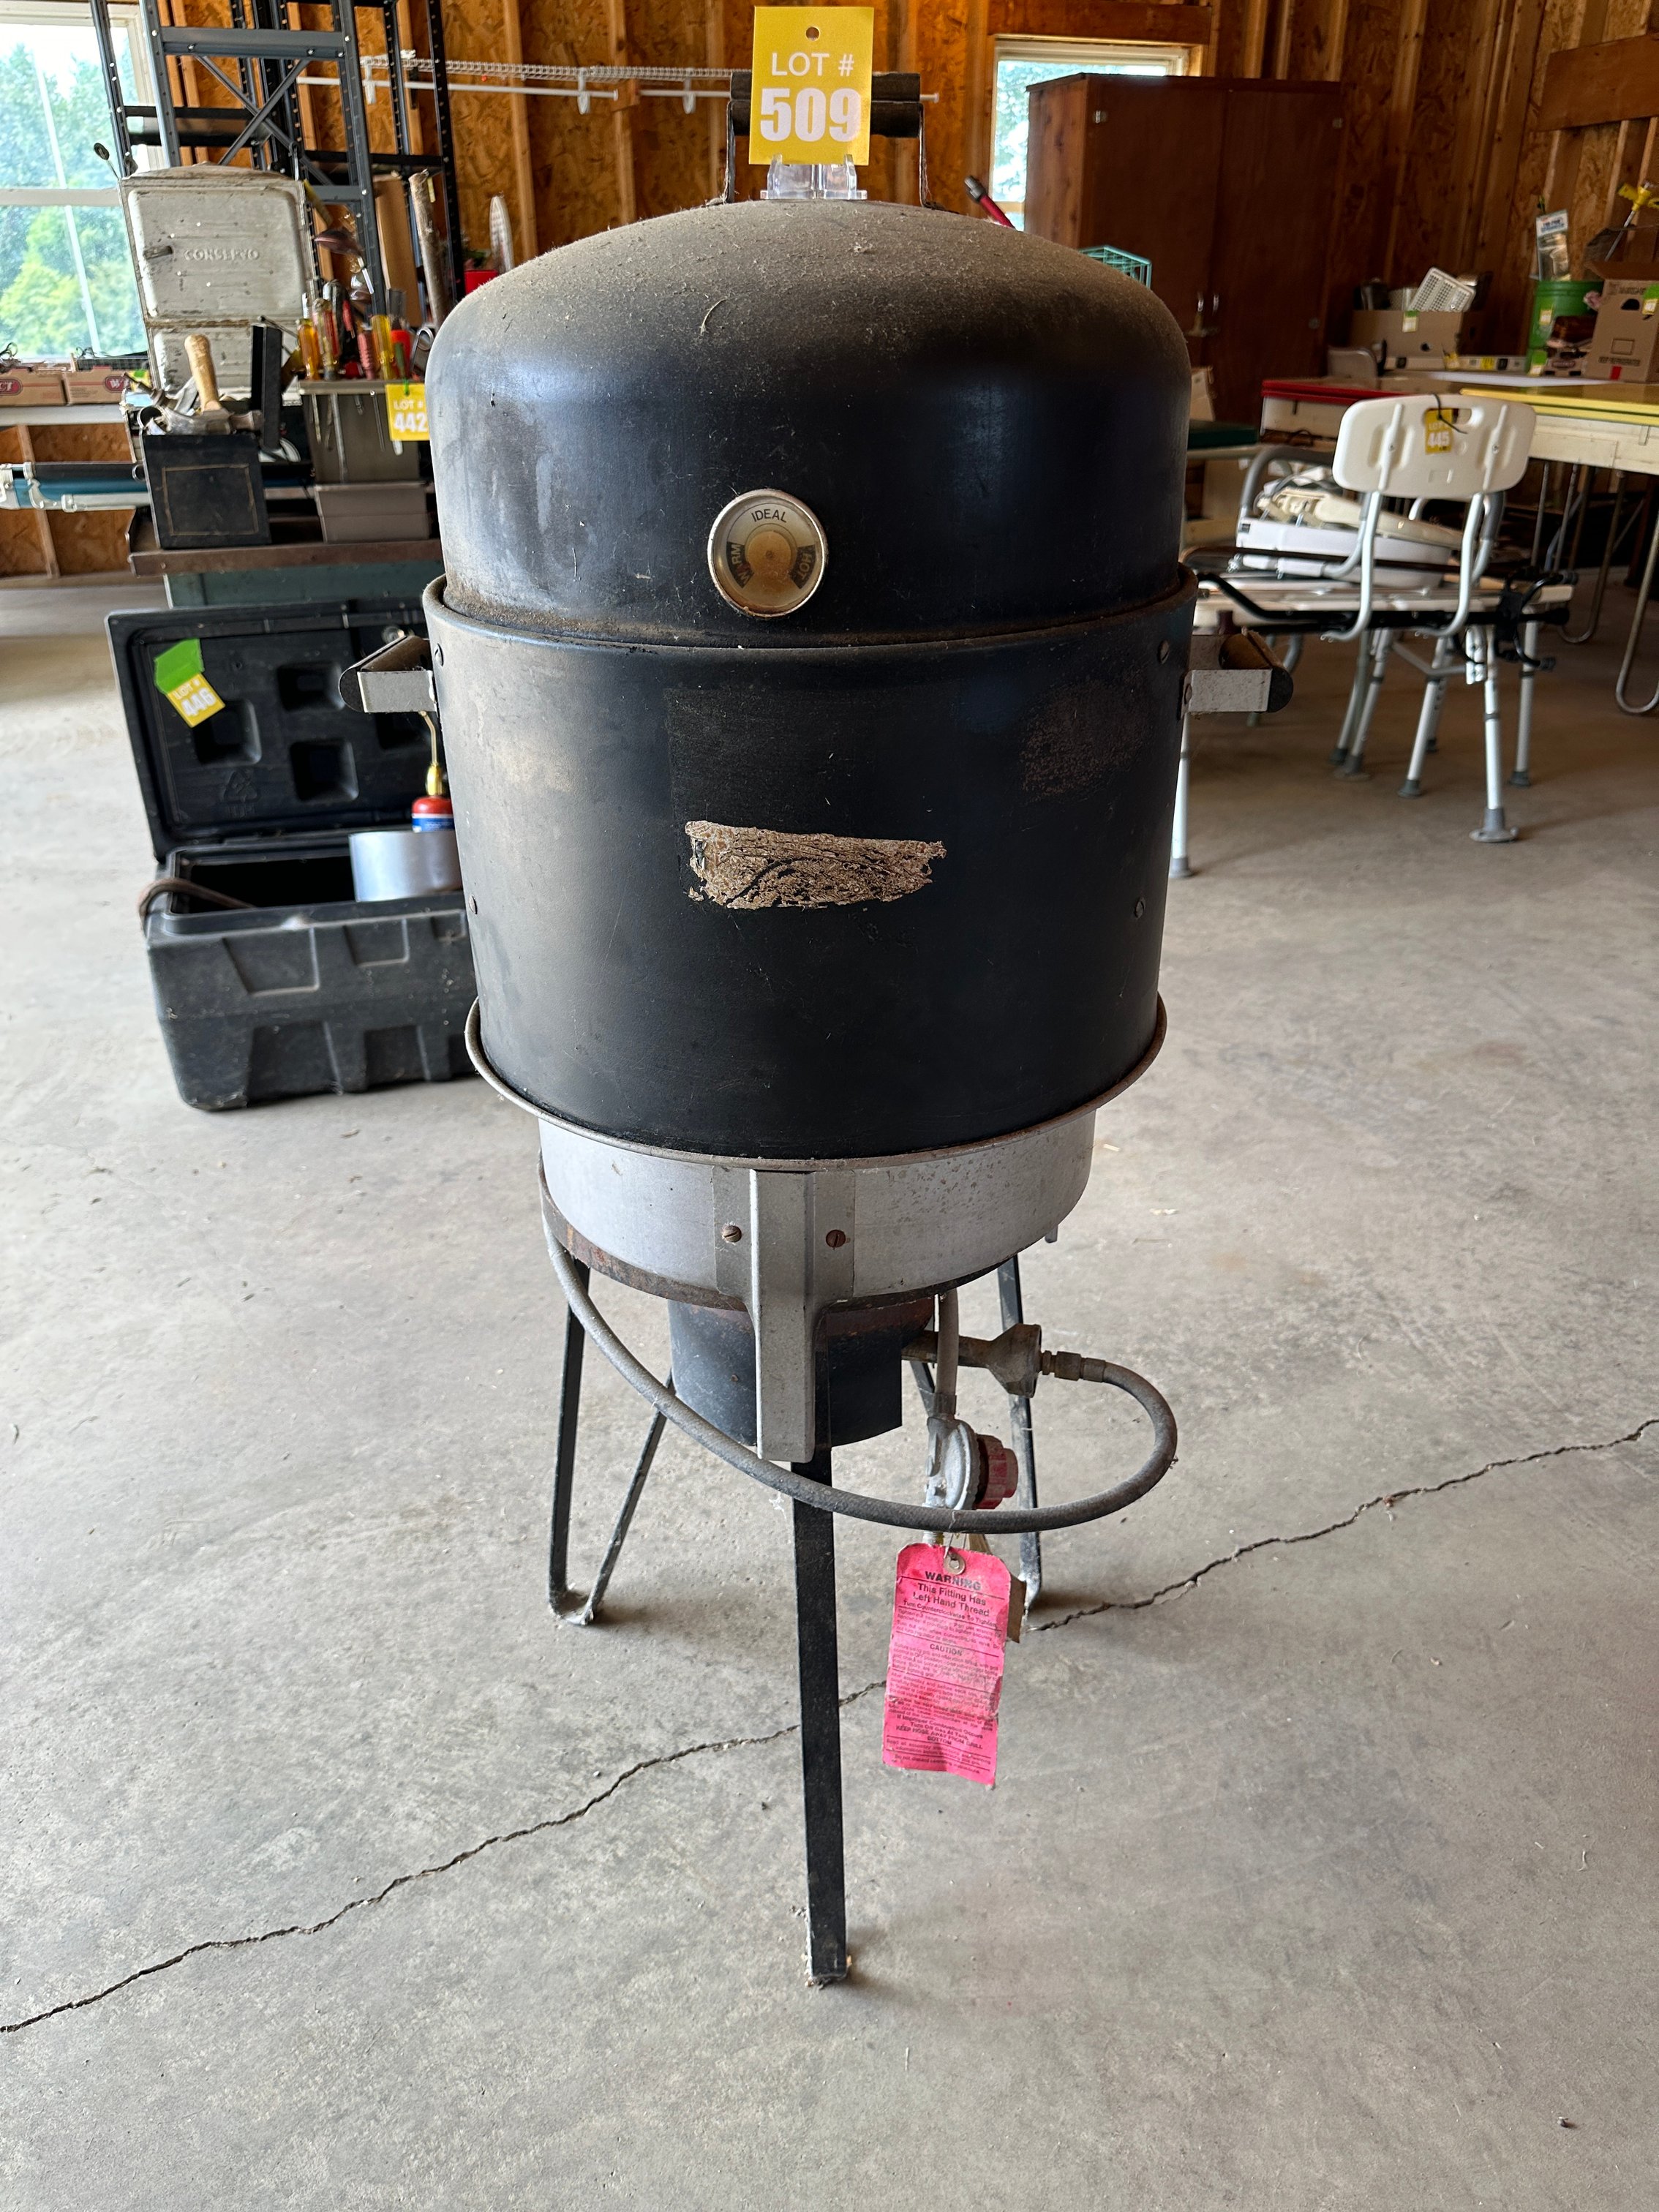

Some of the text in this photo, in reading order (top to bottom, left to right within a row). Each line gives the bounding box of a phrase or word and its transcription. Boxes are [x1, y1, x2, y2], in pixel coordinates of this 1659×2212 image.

[772, 52, 854, 76] LOT #
[760, 87, 861, 142] 509
[393, 399, 414, 410] LOT
[394, 412, 428, 433] 442
[1427, 431, 1450, 448] 445
[751, 508, 788, 523] IDEAL
[731, 543, 750, 583] WRM
[798, 552, 813, 580] HOT
[172, 682, 193, 700] LOT
[181, 688, 217, 717] 446
[925, 1571, 982, 1591] WARNING
[913, 1591, 989, 1617] Left Hand Thread
[917, 1582, 986, 1606] This Fitting Has
[903, 1598, 916, 1607] Turn
[917, 1603, 965, 1619] Counterclockwise
[930, 1644, 962, 1656] CAUTION
[896, 1724, 911, 1732] KEEP
[912, 1726, 928, 1735] HOSE
[948, 1735, 964, 1744] FROM
[902, 1715, 927, 1725] Improper
[929, 1720, 962, 1732] Combustion
[963, 1729, 983, 1739] Occurs
[927, 1735, 952, 1745] BOTTOM
